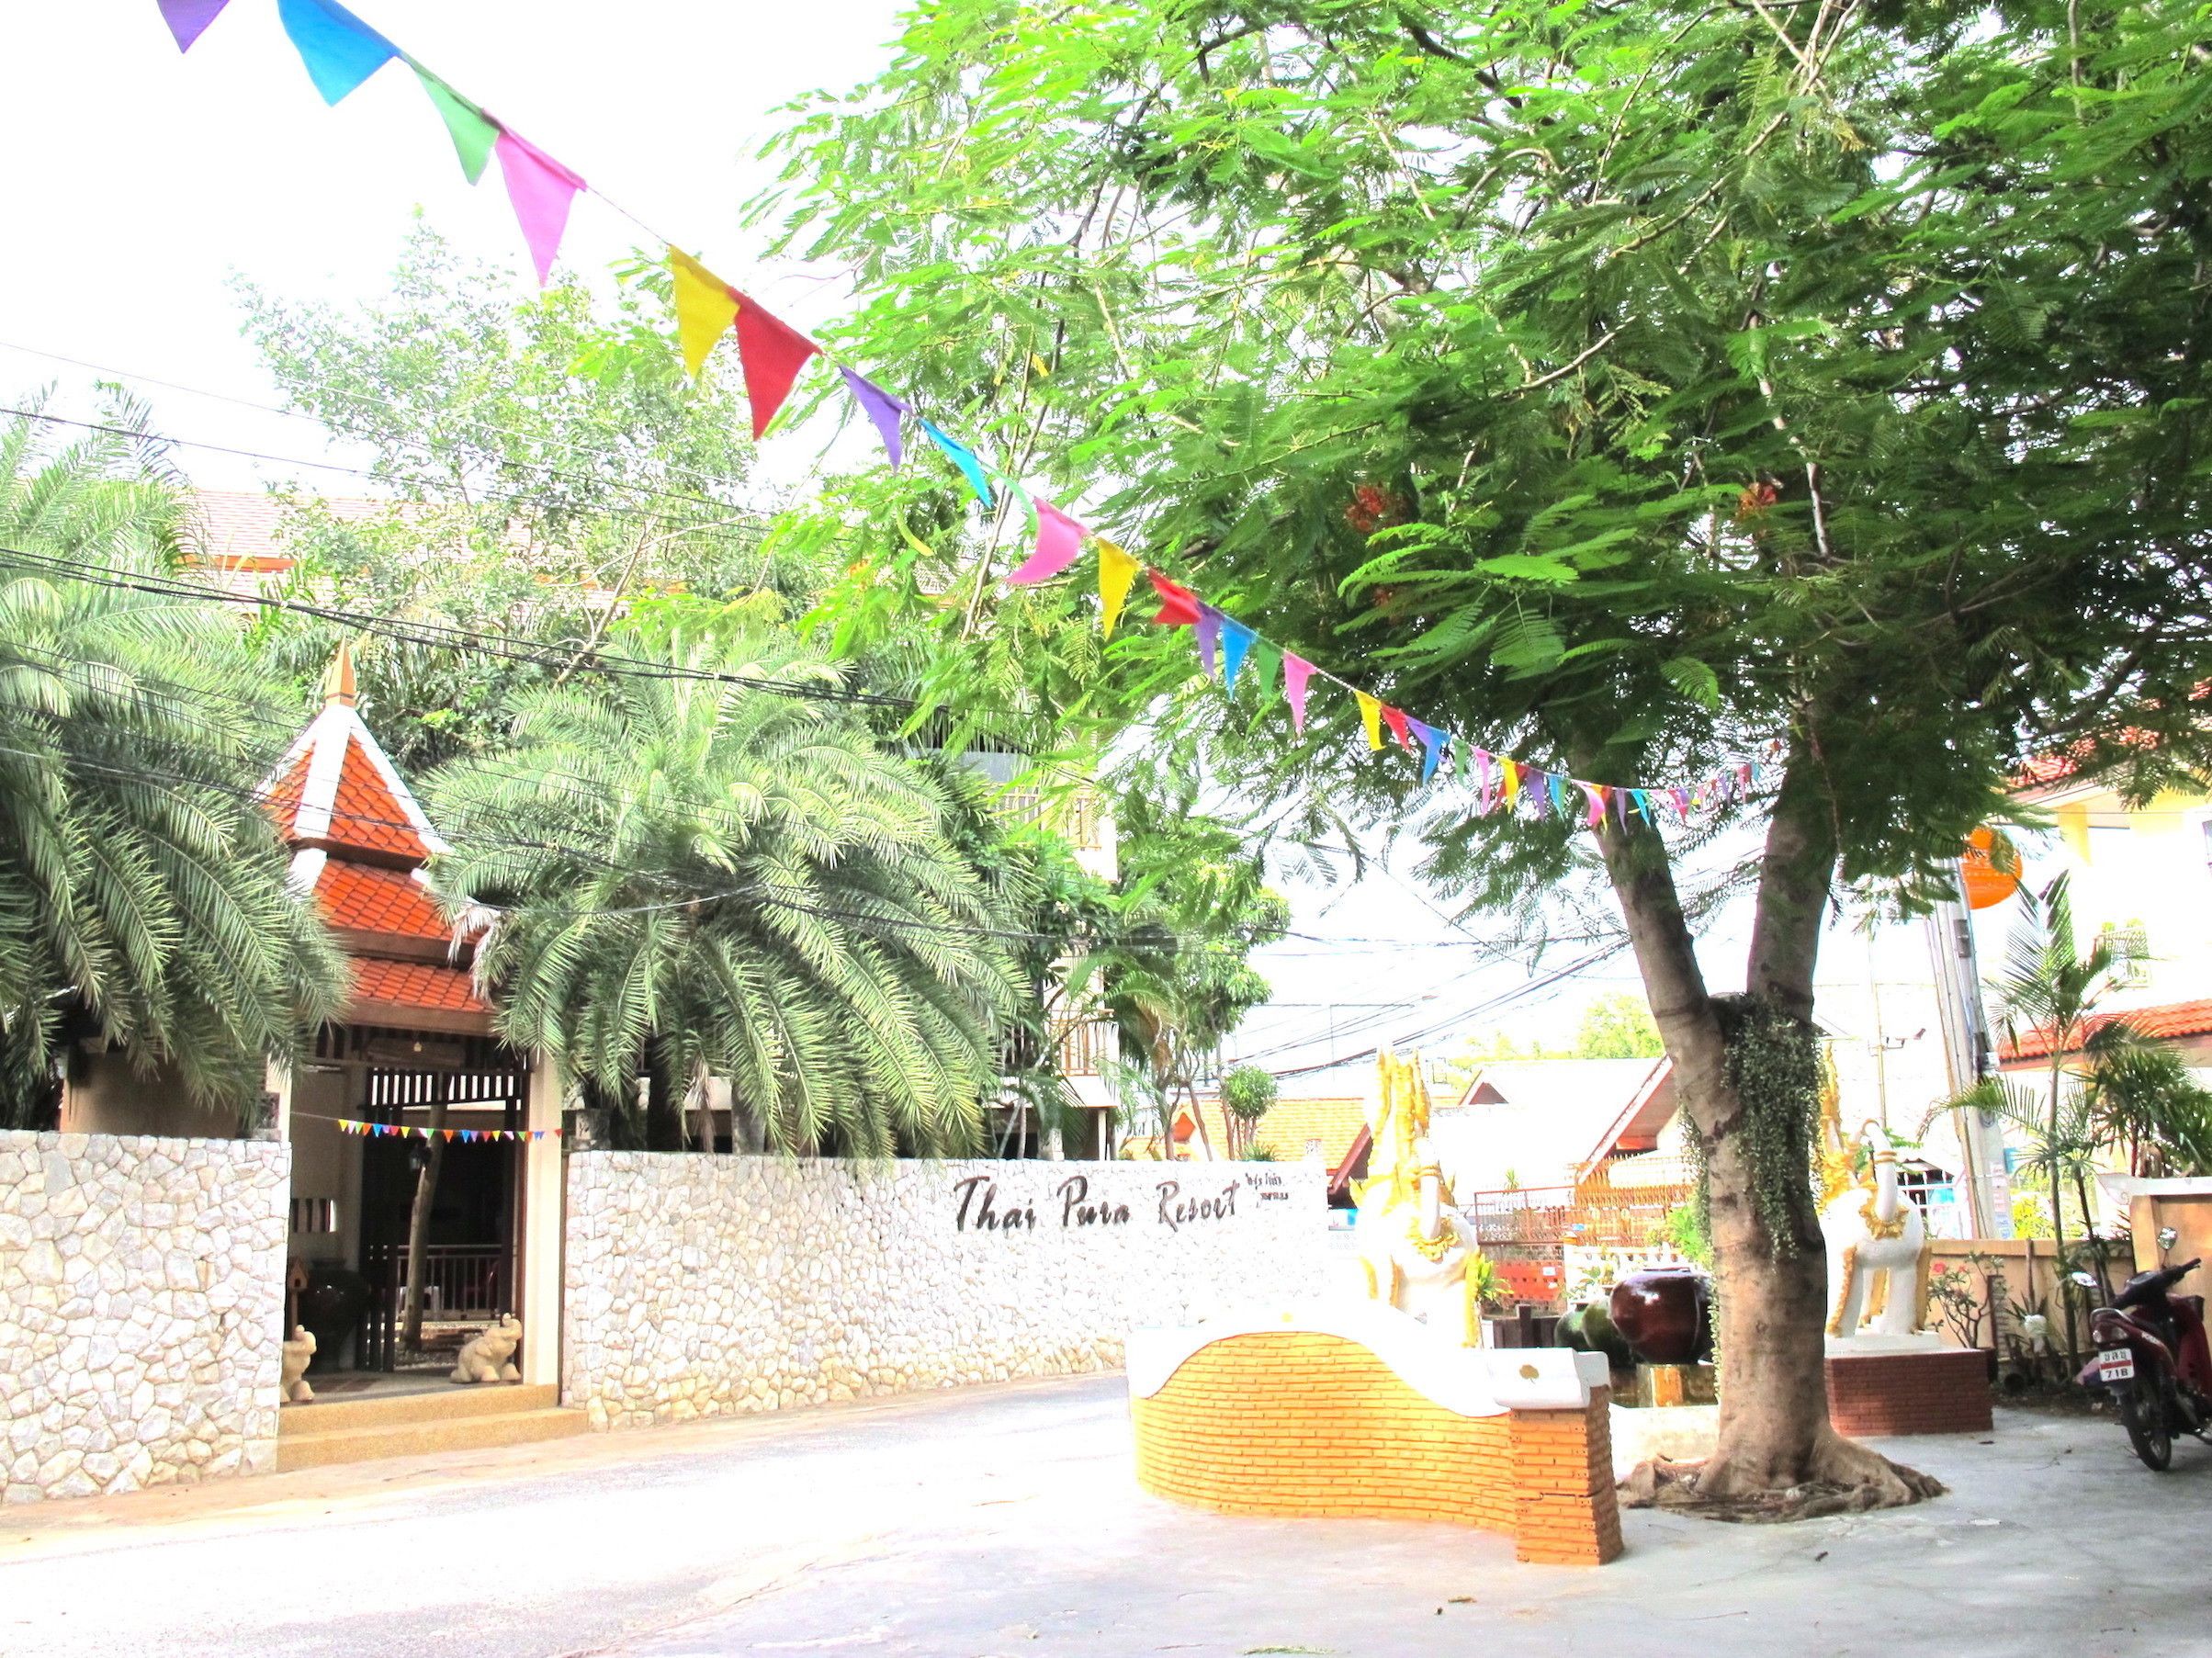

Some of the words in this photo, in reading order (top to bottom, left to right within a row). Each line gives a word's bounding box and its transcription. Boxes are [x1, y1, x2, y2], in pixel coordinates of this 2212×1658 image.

[954, 1176, 1036, 1232] Thai
[1056, 1175, 1130, 1227] Pura
[1156, 1179, 1240, 1233] Resort
